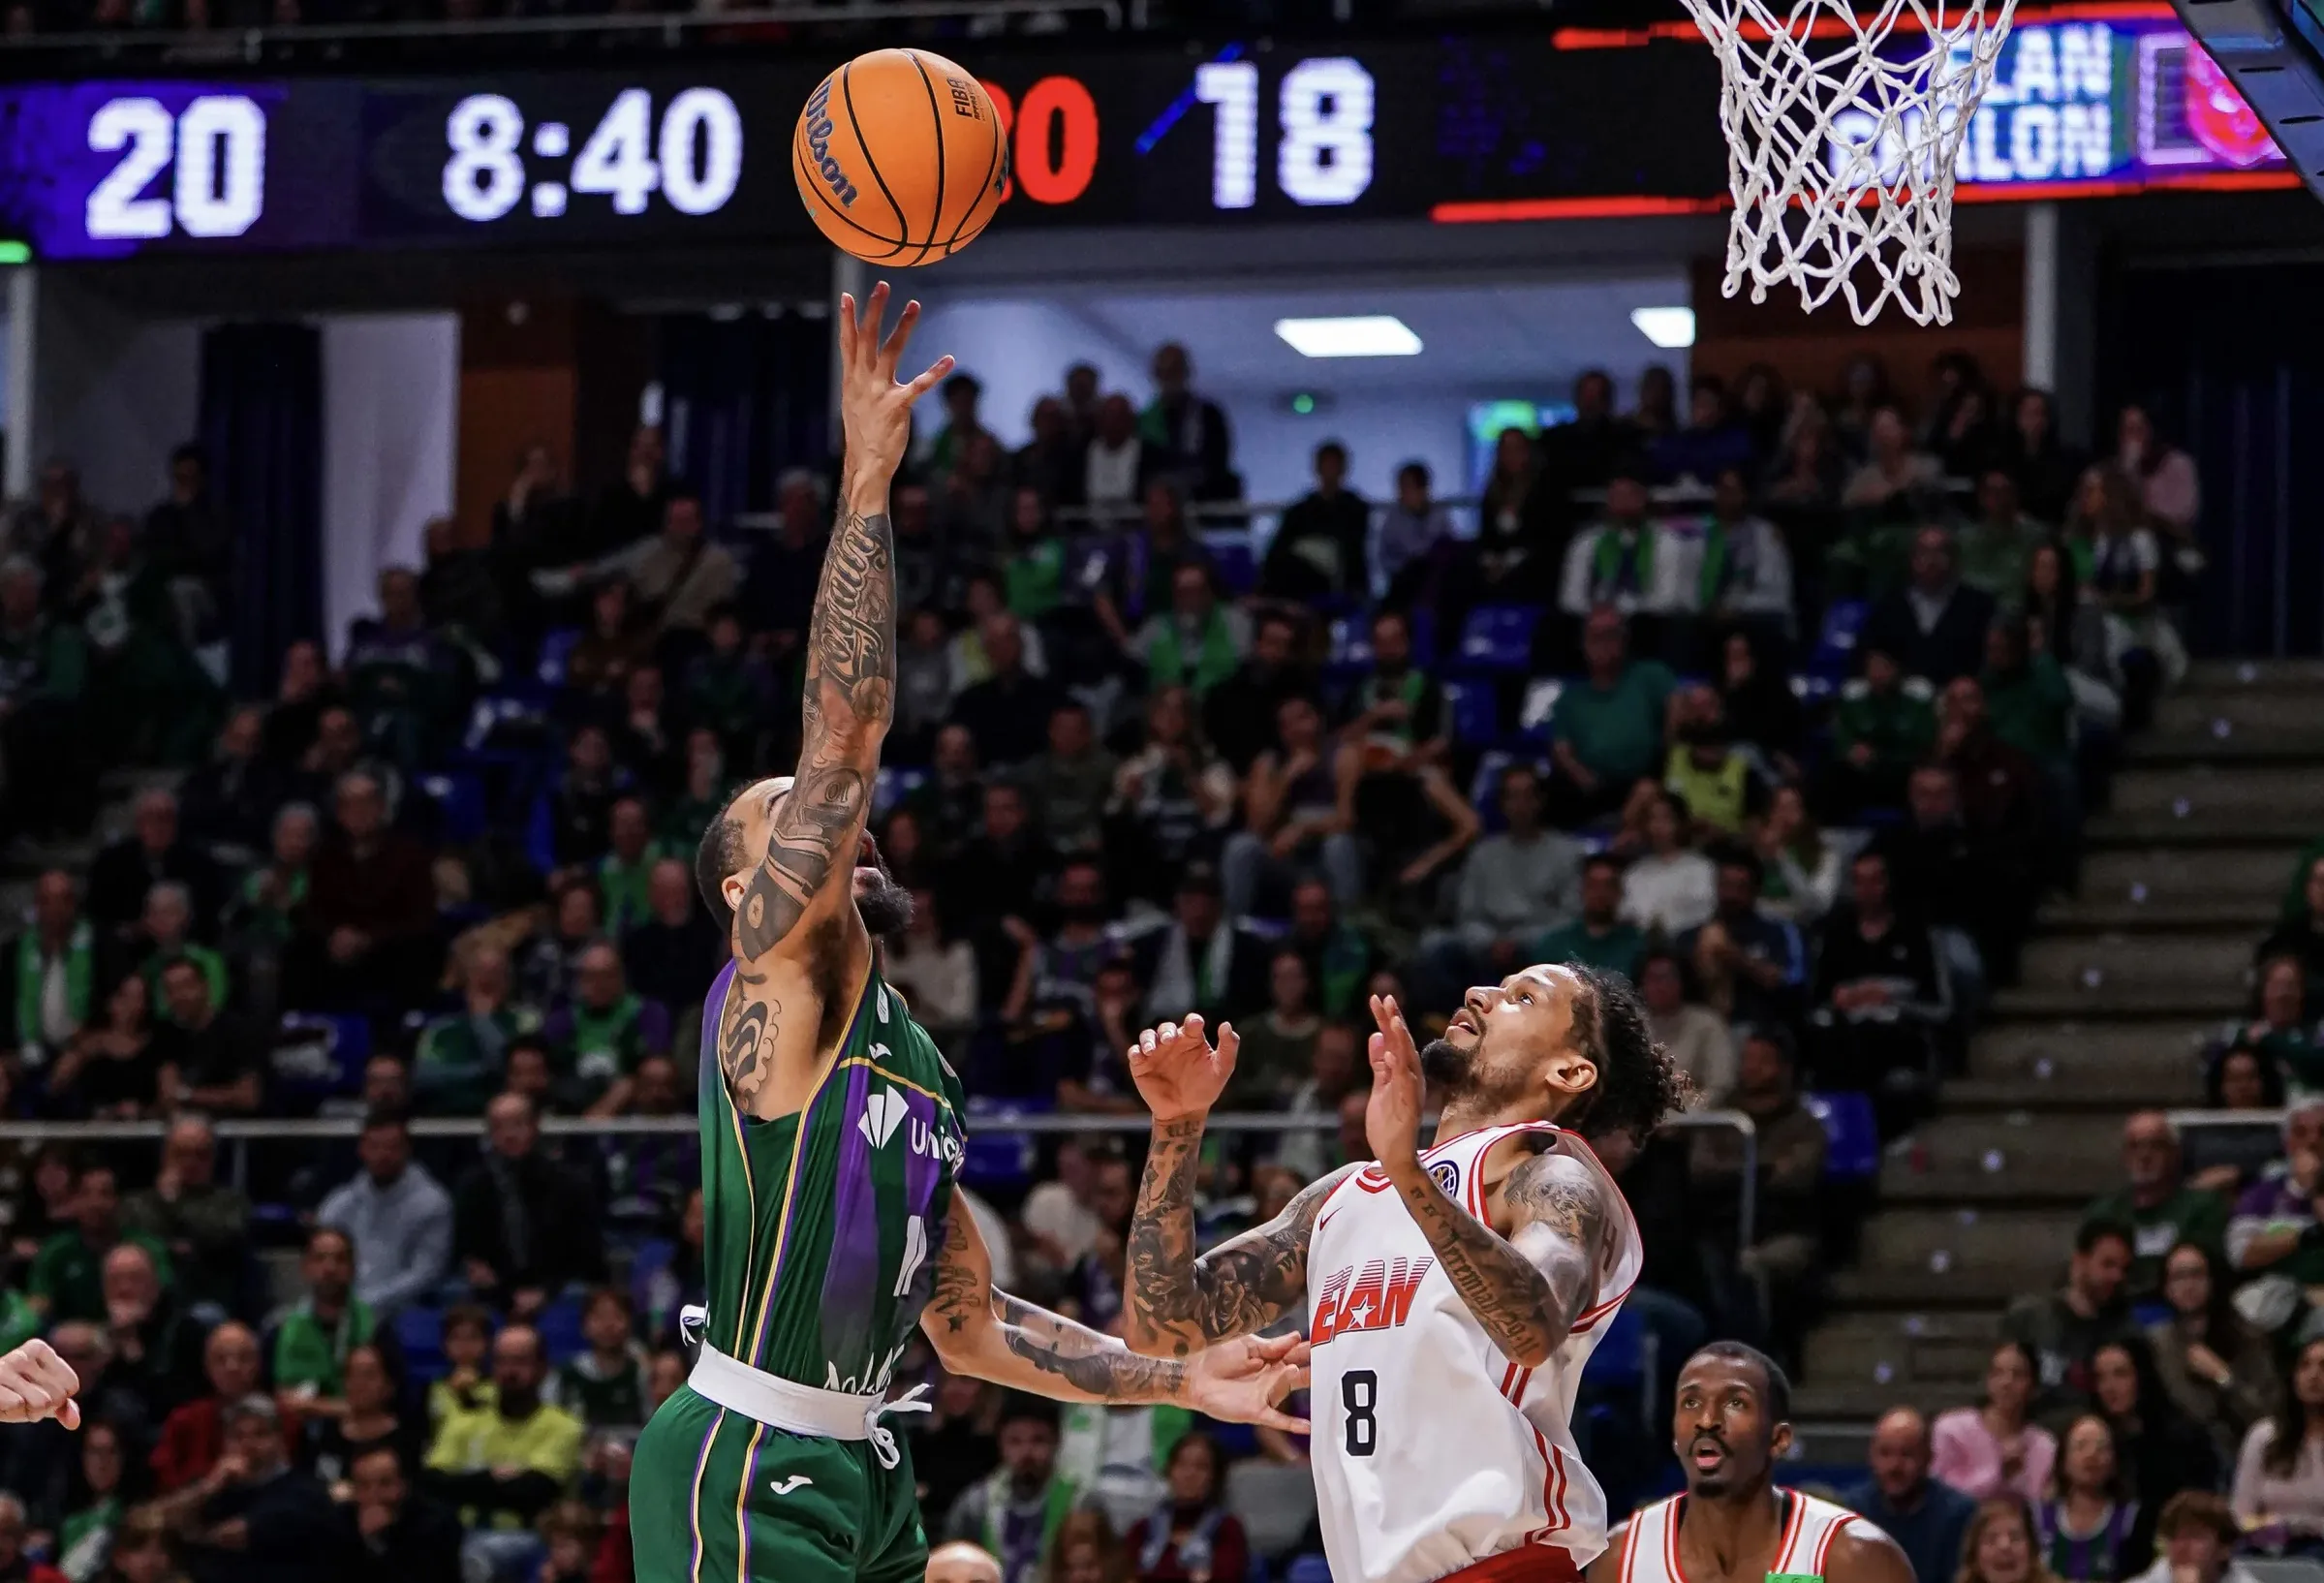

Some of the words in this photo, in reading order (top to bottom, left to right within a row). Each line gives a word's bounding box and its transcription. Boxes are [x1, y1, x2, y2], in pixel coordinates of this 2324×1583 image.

[85, 95, 266, 239] 20
[442, 85, 743, 222] 8:40
[806, 77, 858, 208] Wilson
[1193, 56, 1376, 209] 18
[1310, 1256, 1435, 1349] ELAN
[1341, 1369, 1379, 1457] 8
